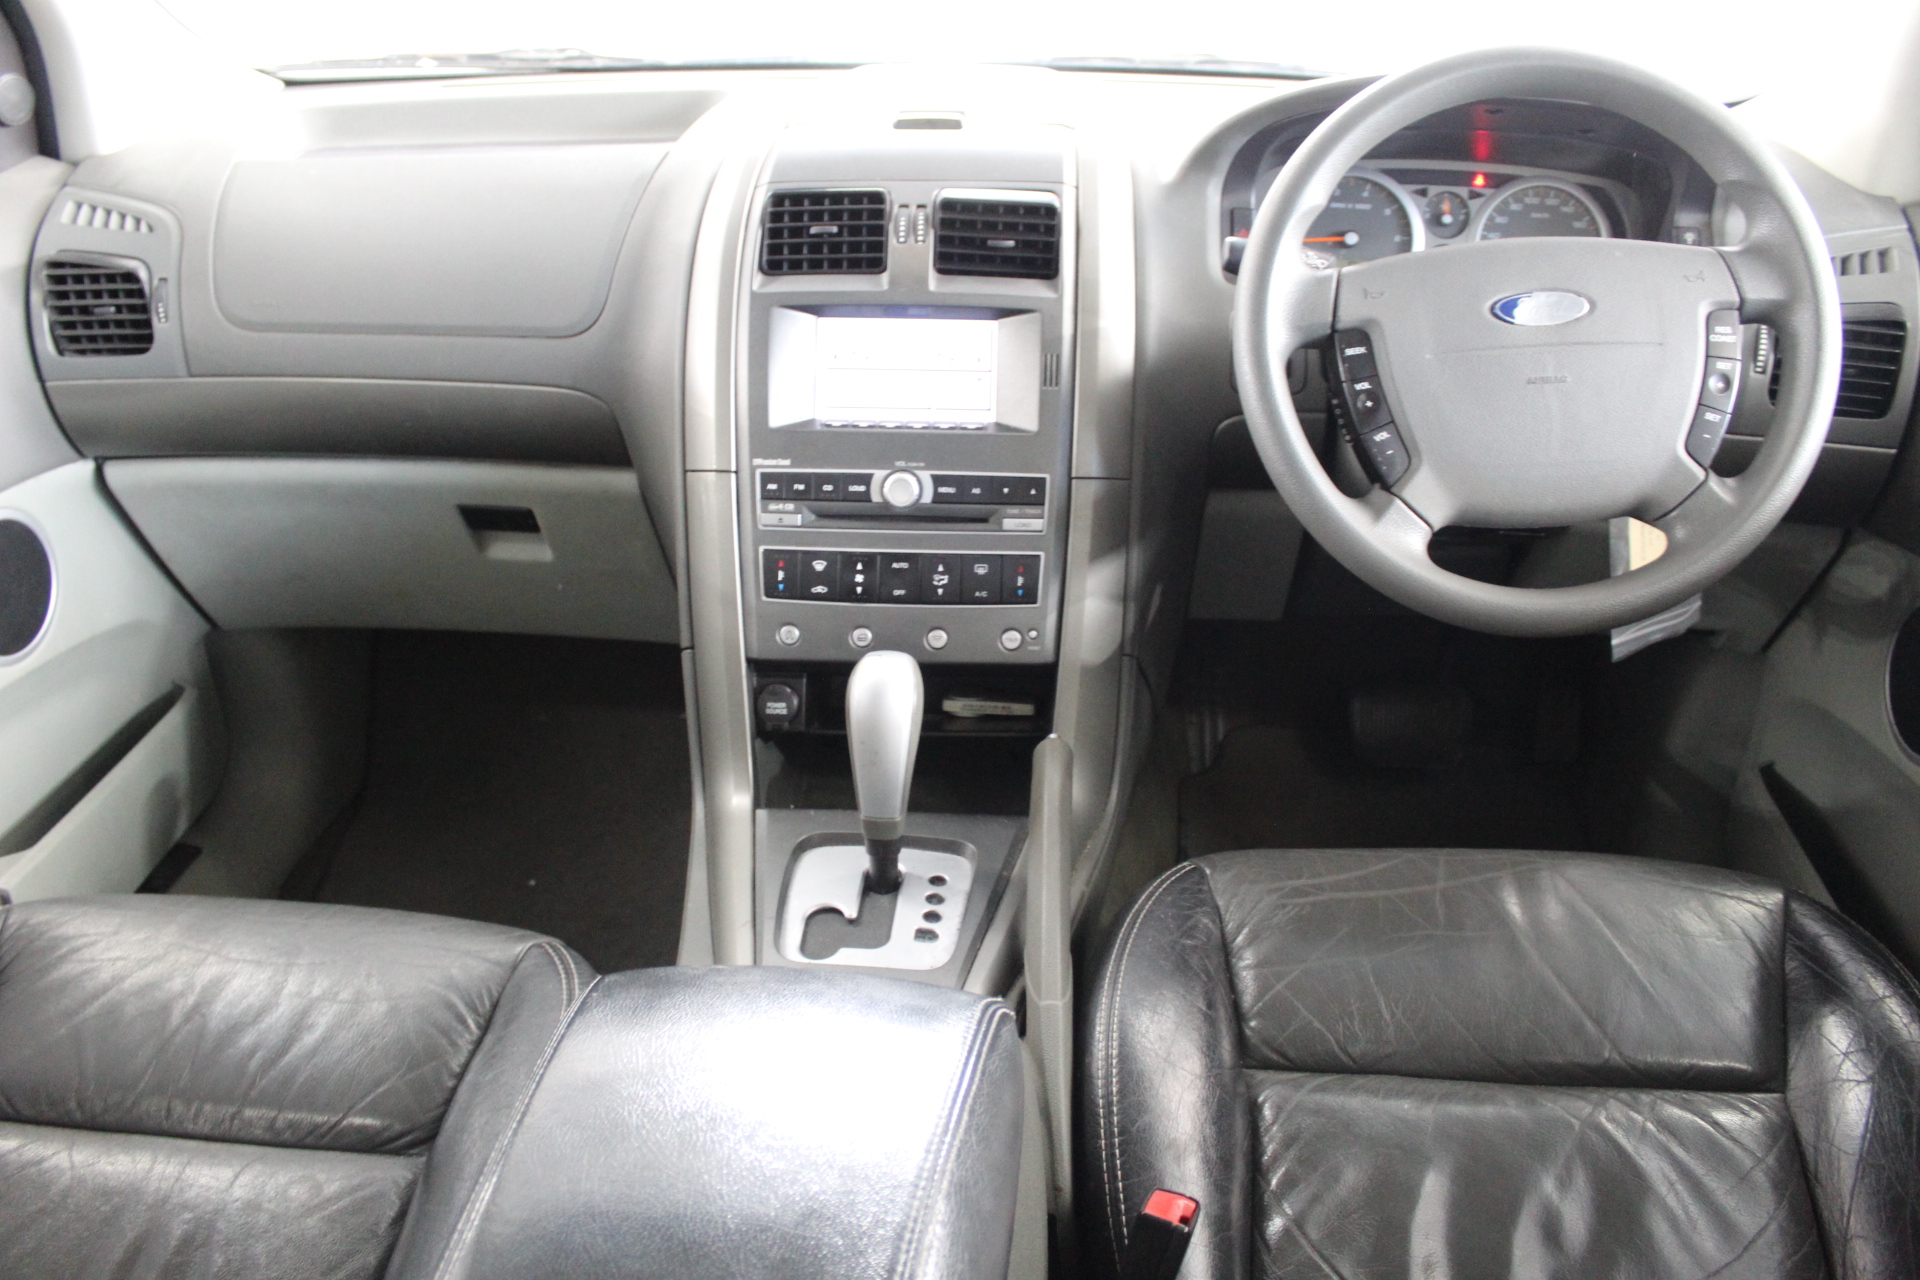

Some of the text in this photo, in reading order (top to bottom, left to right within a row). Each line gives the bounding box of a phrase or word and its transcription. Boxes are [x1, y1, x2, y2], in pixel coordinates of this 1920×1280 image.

[1344, 346, 1368, 356] SEEK
[1715, 361, 1733, 370] SET
[1353, 381, 1373, 391] VOL
[1703, 411, 1723, 423] SET
[1372, 430, 1392, 442] VOL
[793, 483, 806, 491] FM
[822, 484, 834, 492] CD
[937, 486, 957, 494] MENU
